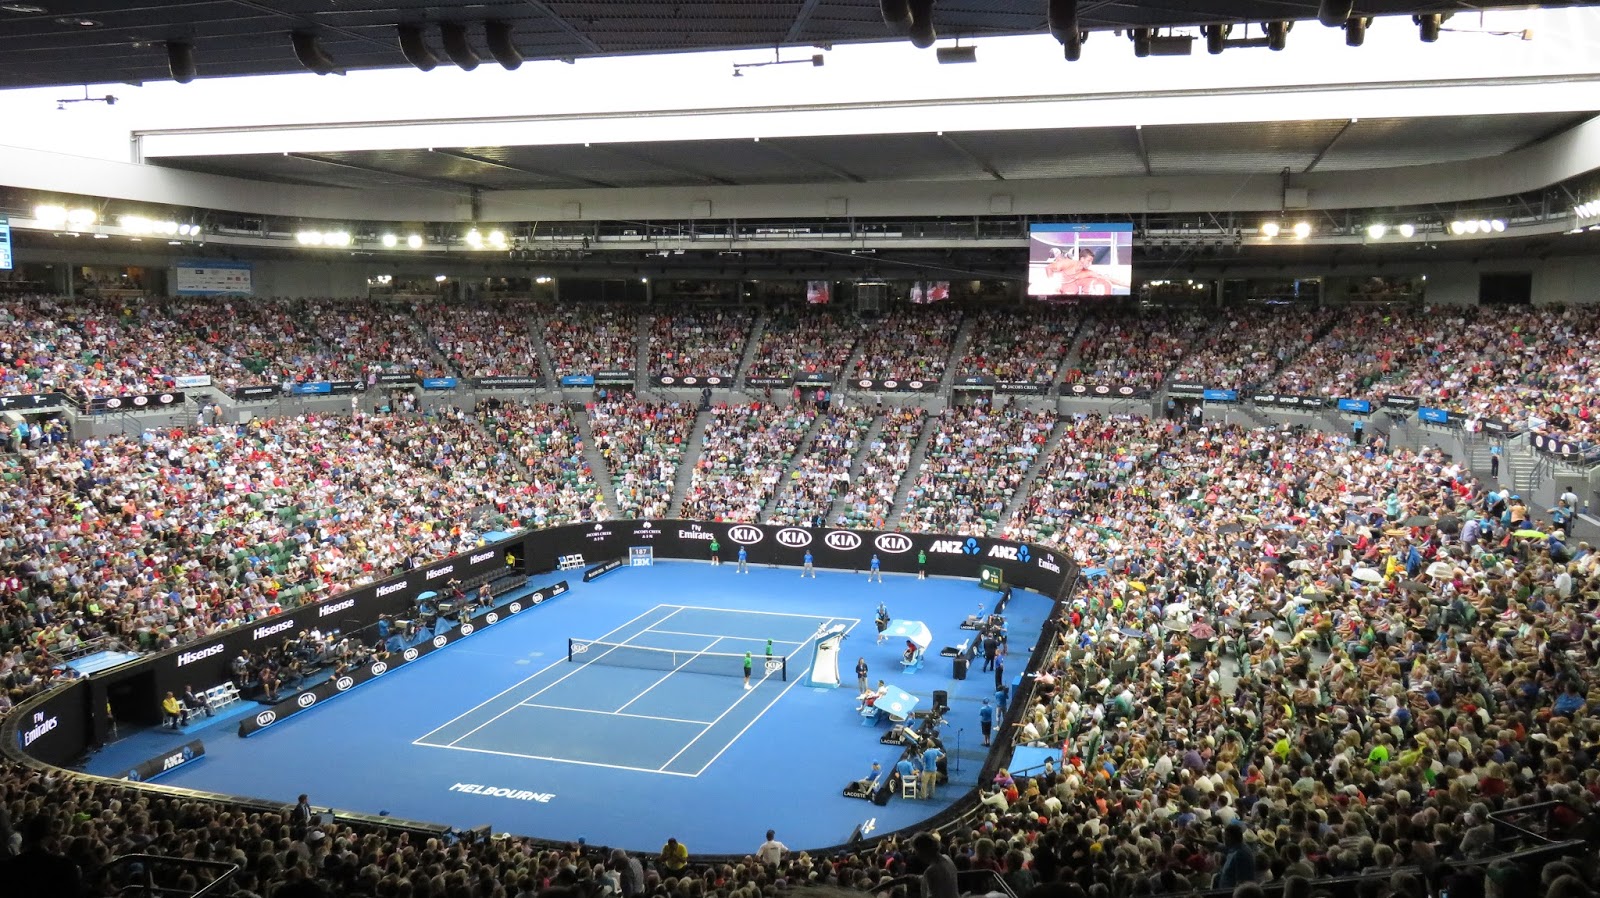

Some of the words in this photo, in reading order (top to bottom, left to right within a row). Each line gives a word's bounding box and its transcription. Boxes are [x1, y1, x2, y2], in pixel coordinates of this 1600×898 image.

[678, 530, 714, 540] Emirates
[734, 528, 756, 540] KIA
[782, 532, 805, 544] KIA
[831, 534, 854, 546] KIA
[881, 537, 905, 549] KIA
[929, 540, 964, 554] ANZ
[470, 550, 495, 565] Hisense
[988, 545, 1018, 560] ANZ
[633, 558, 650, 566] IBM
[1038, 558, 1061, 574] Emirates
[426, 564, 453, 580] Hisense
[376, 580, 407, 598] Hisense
[319, 598, 355, 617] Hisense
[253, 619, 294, 641] Hisense
[177, 643, 224, 667] Hisense
[33, 711, 44, 725] Fly
[24, 716, 58, 747] Emirates
[163, 752, 185, 770] ANZ
[448, 782, 556, 803] MELBOURNE
